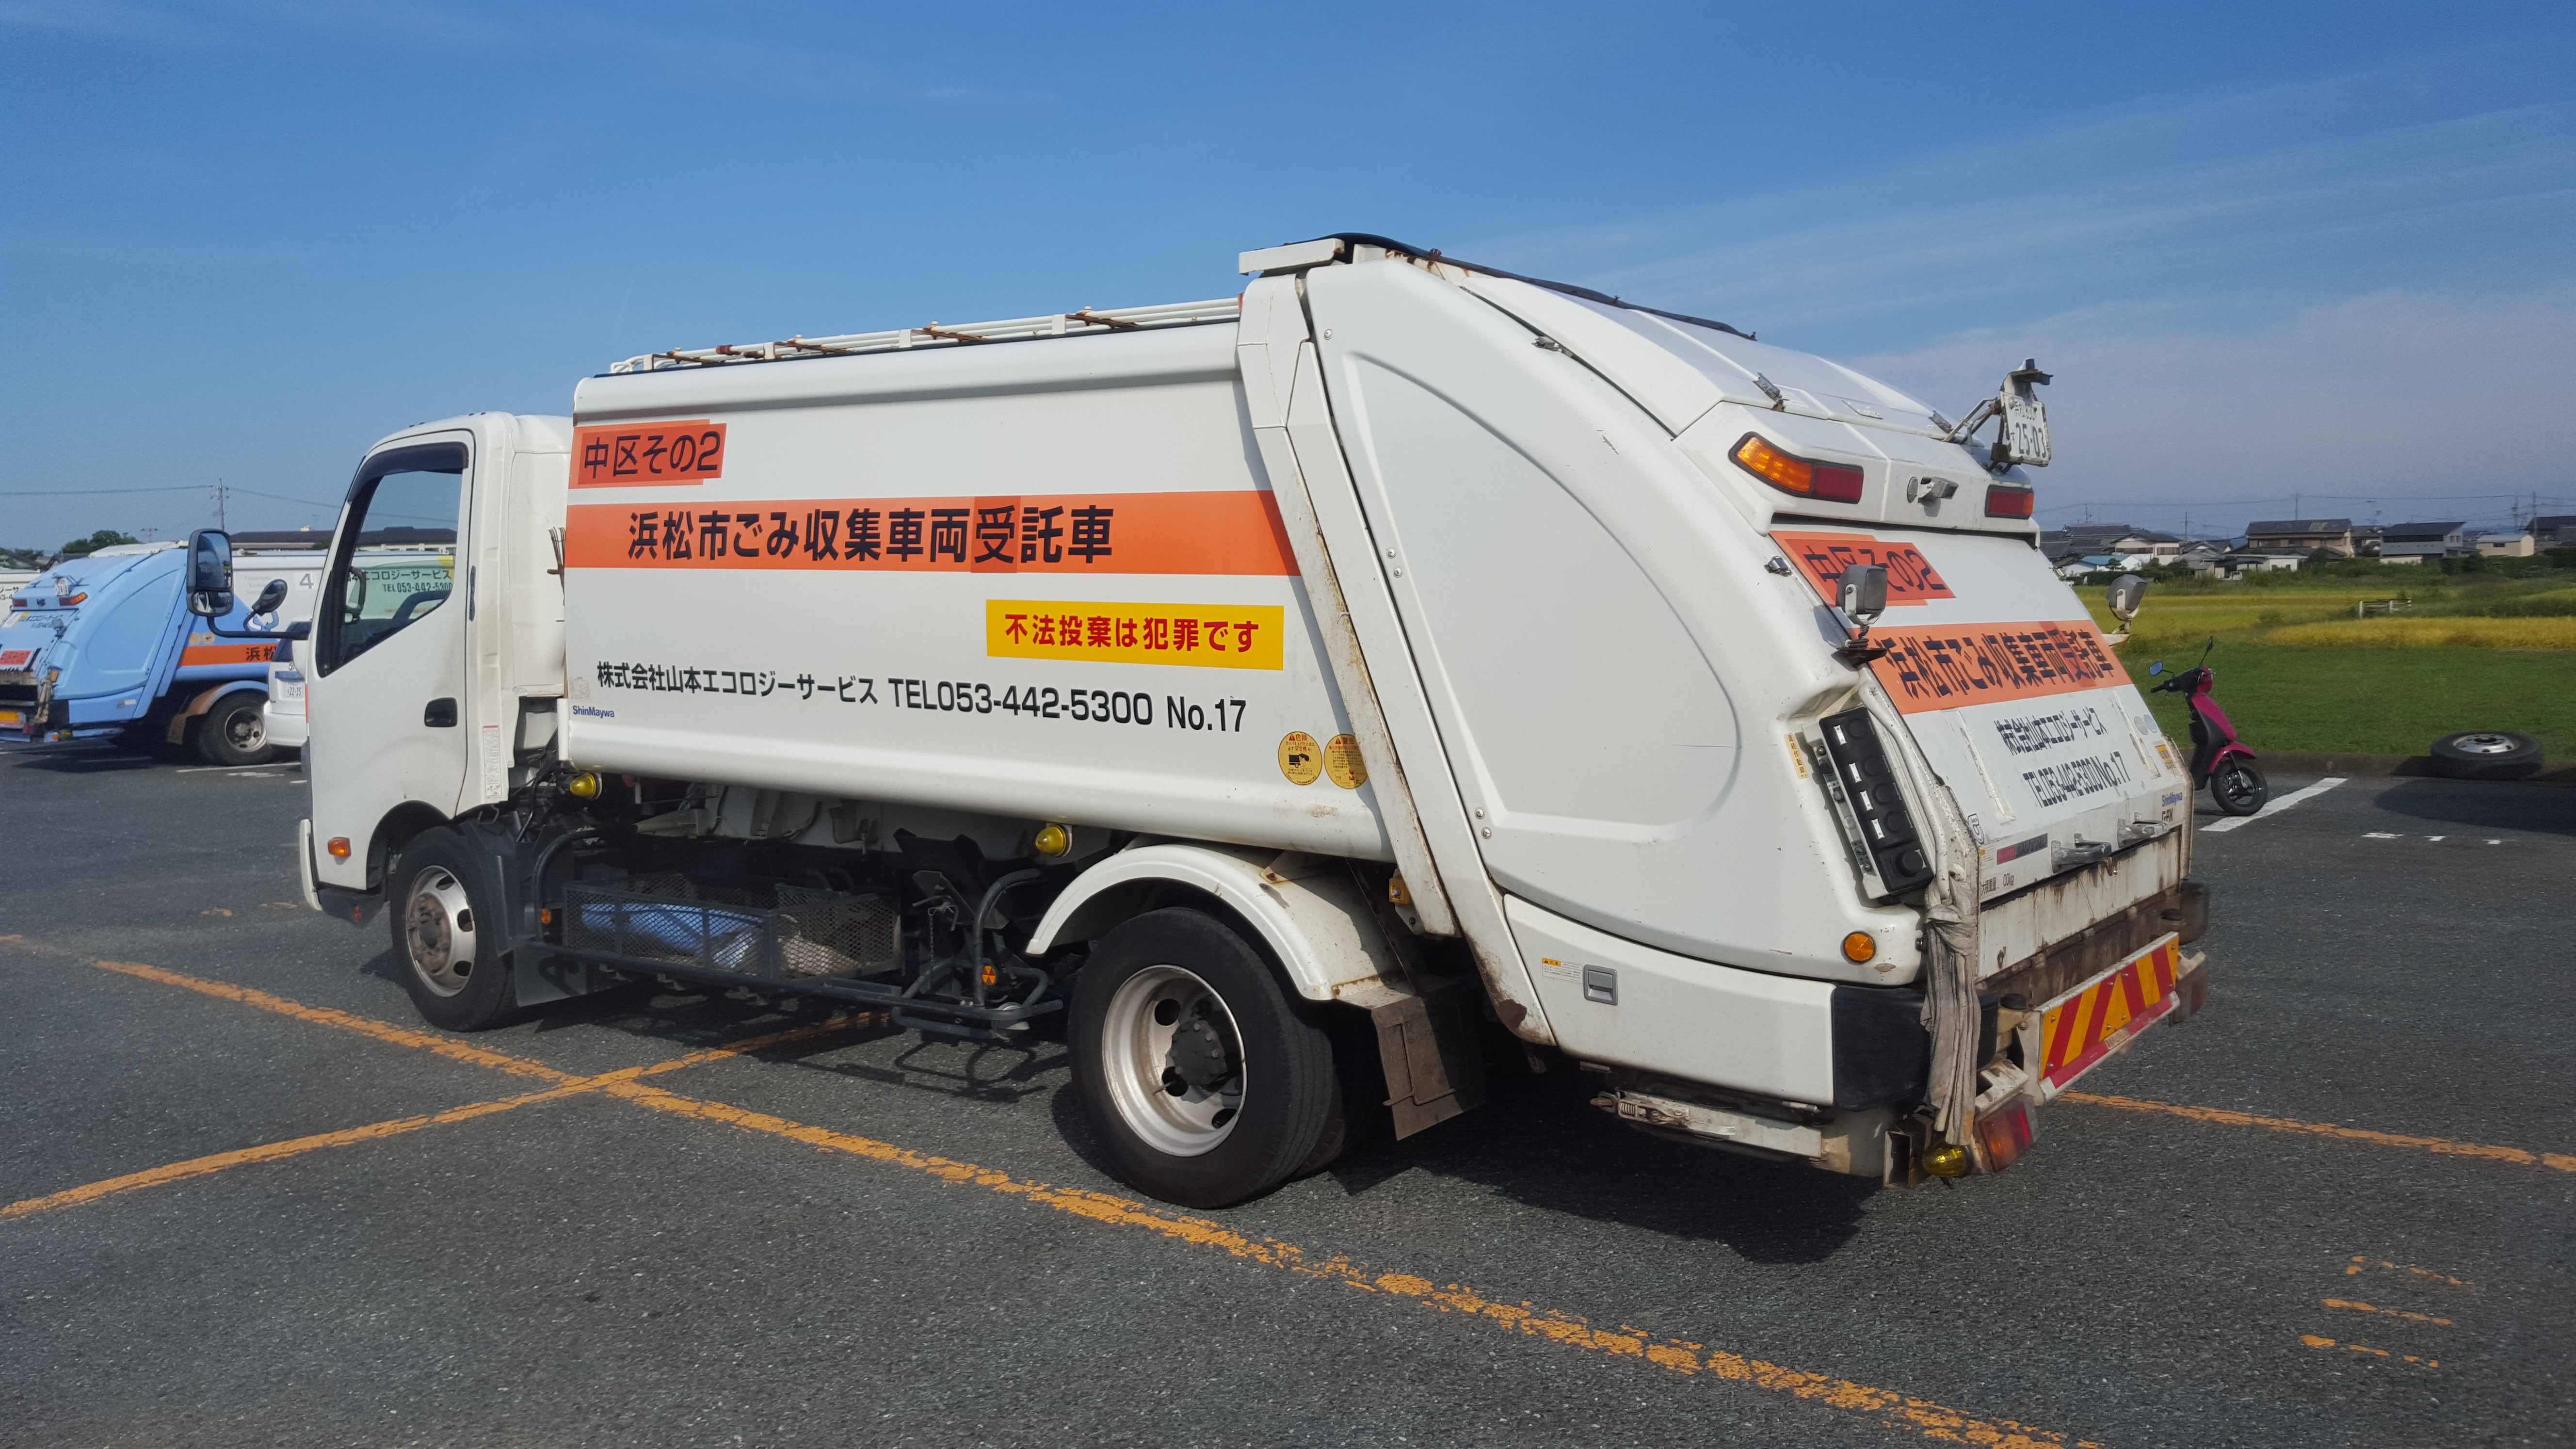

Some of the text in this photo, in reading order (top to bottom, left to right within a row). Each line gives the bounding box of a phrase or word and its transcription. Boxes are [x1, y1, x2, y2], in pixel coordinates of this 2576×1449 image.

[583, 431, 721, 479] 中区その2
[628, 504, 1114, 564] 浜松市ごみ収集車両受託車
[299, 573, 314, 589] 4
[1005, 614, 1259, 652] 不法投棄は犯罪です
[1873, 628, 2113, 699] 浜松市ごみ収集車両受託車
[573, 705, 615, 719] ShinMaywa
[597, 660, 878, 705] 株式会社山本エコロジーサービス
[888, 677, 1153, 725] TEL053-442-5300
[1167, 695, 1247, 733] No.17
